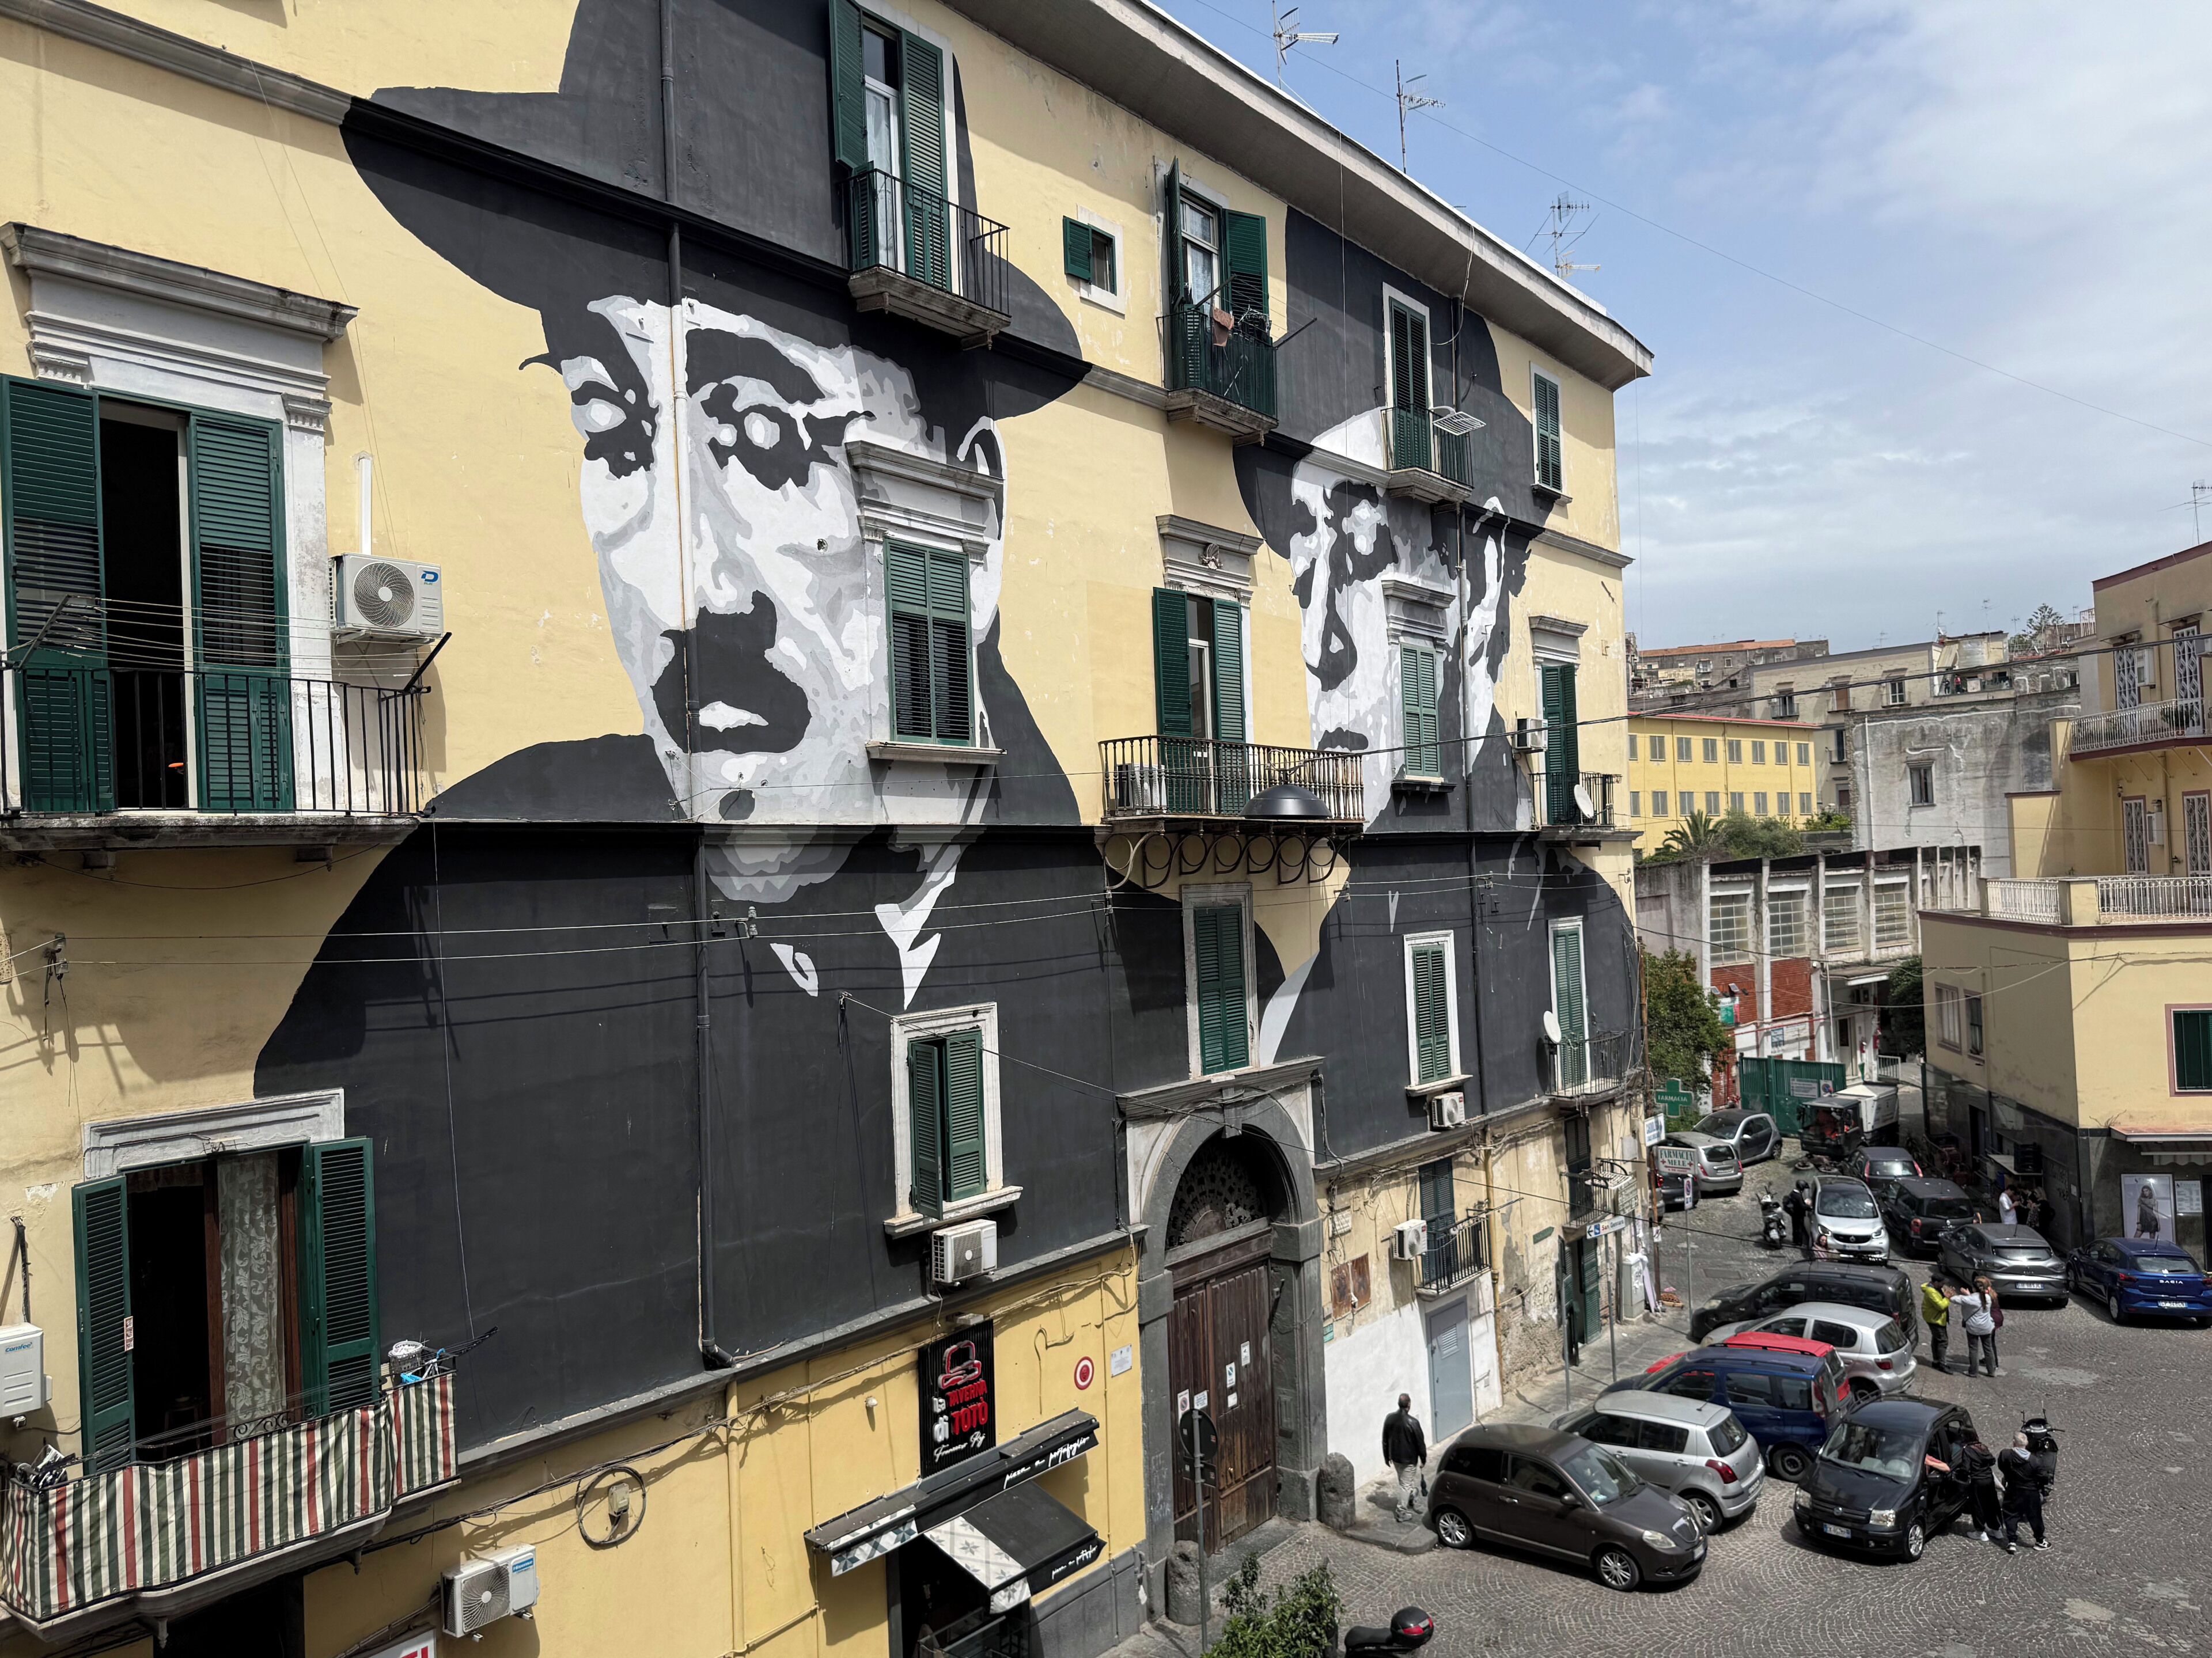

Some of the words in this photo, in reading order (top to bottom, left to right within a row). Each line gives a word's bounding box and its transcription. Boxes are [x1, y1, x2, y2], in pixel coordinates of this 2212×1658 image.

[1660, 1149, 1694, 1162] FARMACIA
[1668, 1159, 1687, 1167] MELE
[946, 1379, 987, 1407] TAVERNA
[933, 1414, 949, 1442] di
